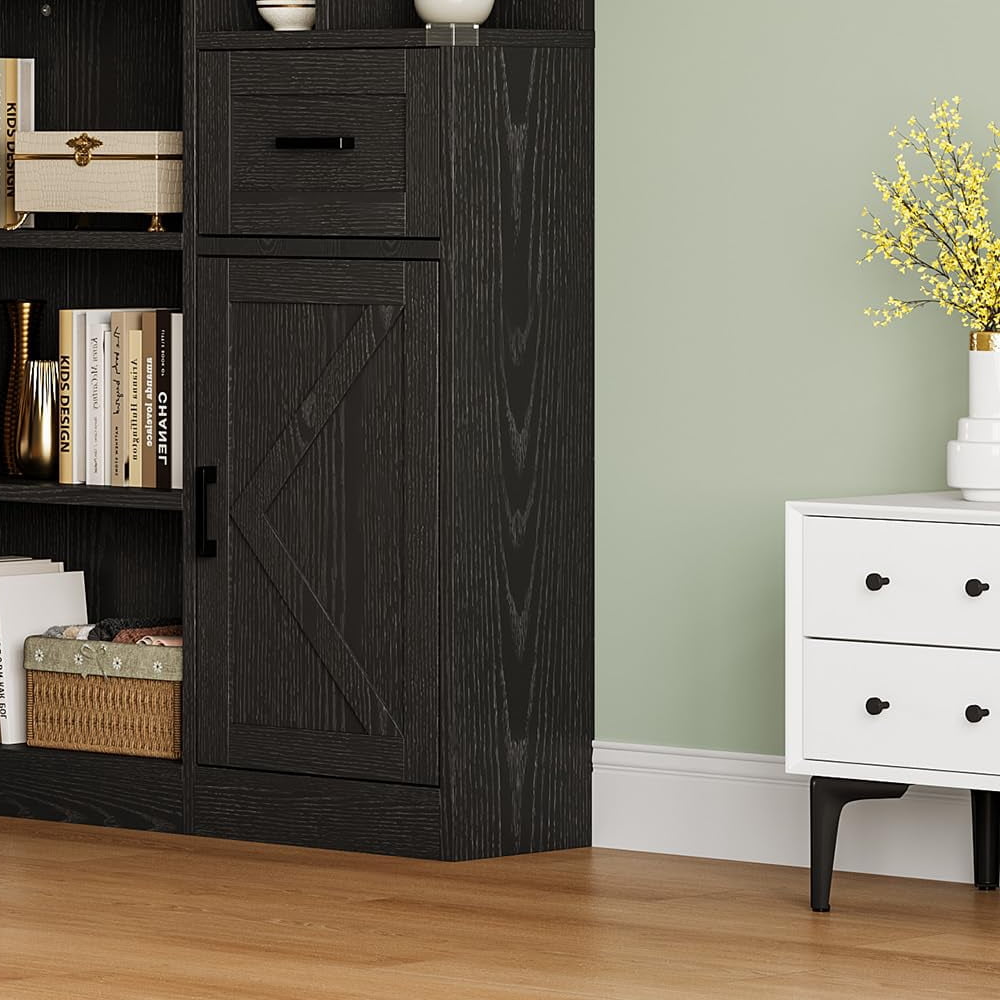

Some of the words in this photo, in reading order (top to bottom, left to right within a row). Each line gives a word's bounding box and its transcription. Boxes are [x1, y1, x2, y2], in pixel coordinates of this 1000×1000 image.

[7, 103, 16, 137] KIDS
[7, 142, 15, 197] DESIGN
[61, 355, 69, 391] KIDS
[61, 396, 69, 452] DESIGN
[0, 703, 7, 720] БОГ
